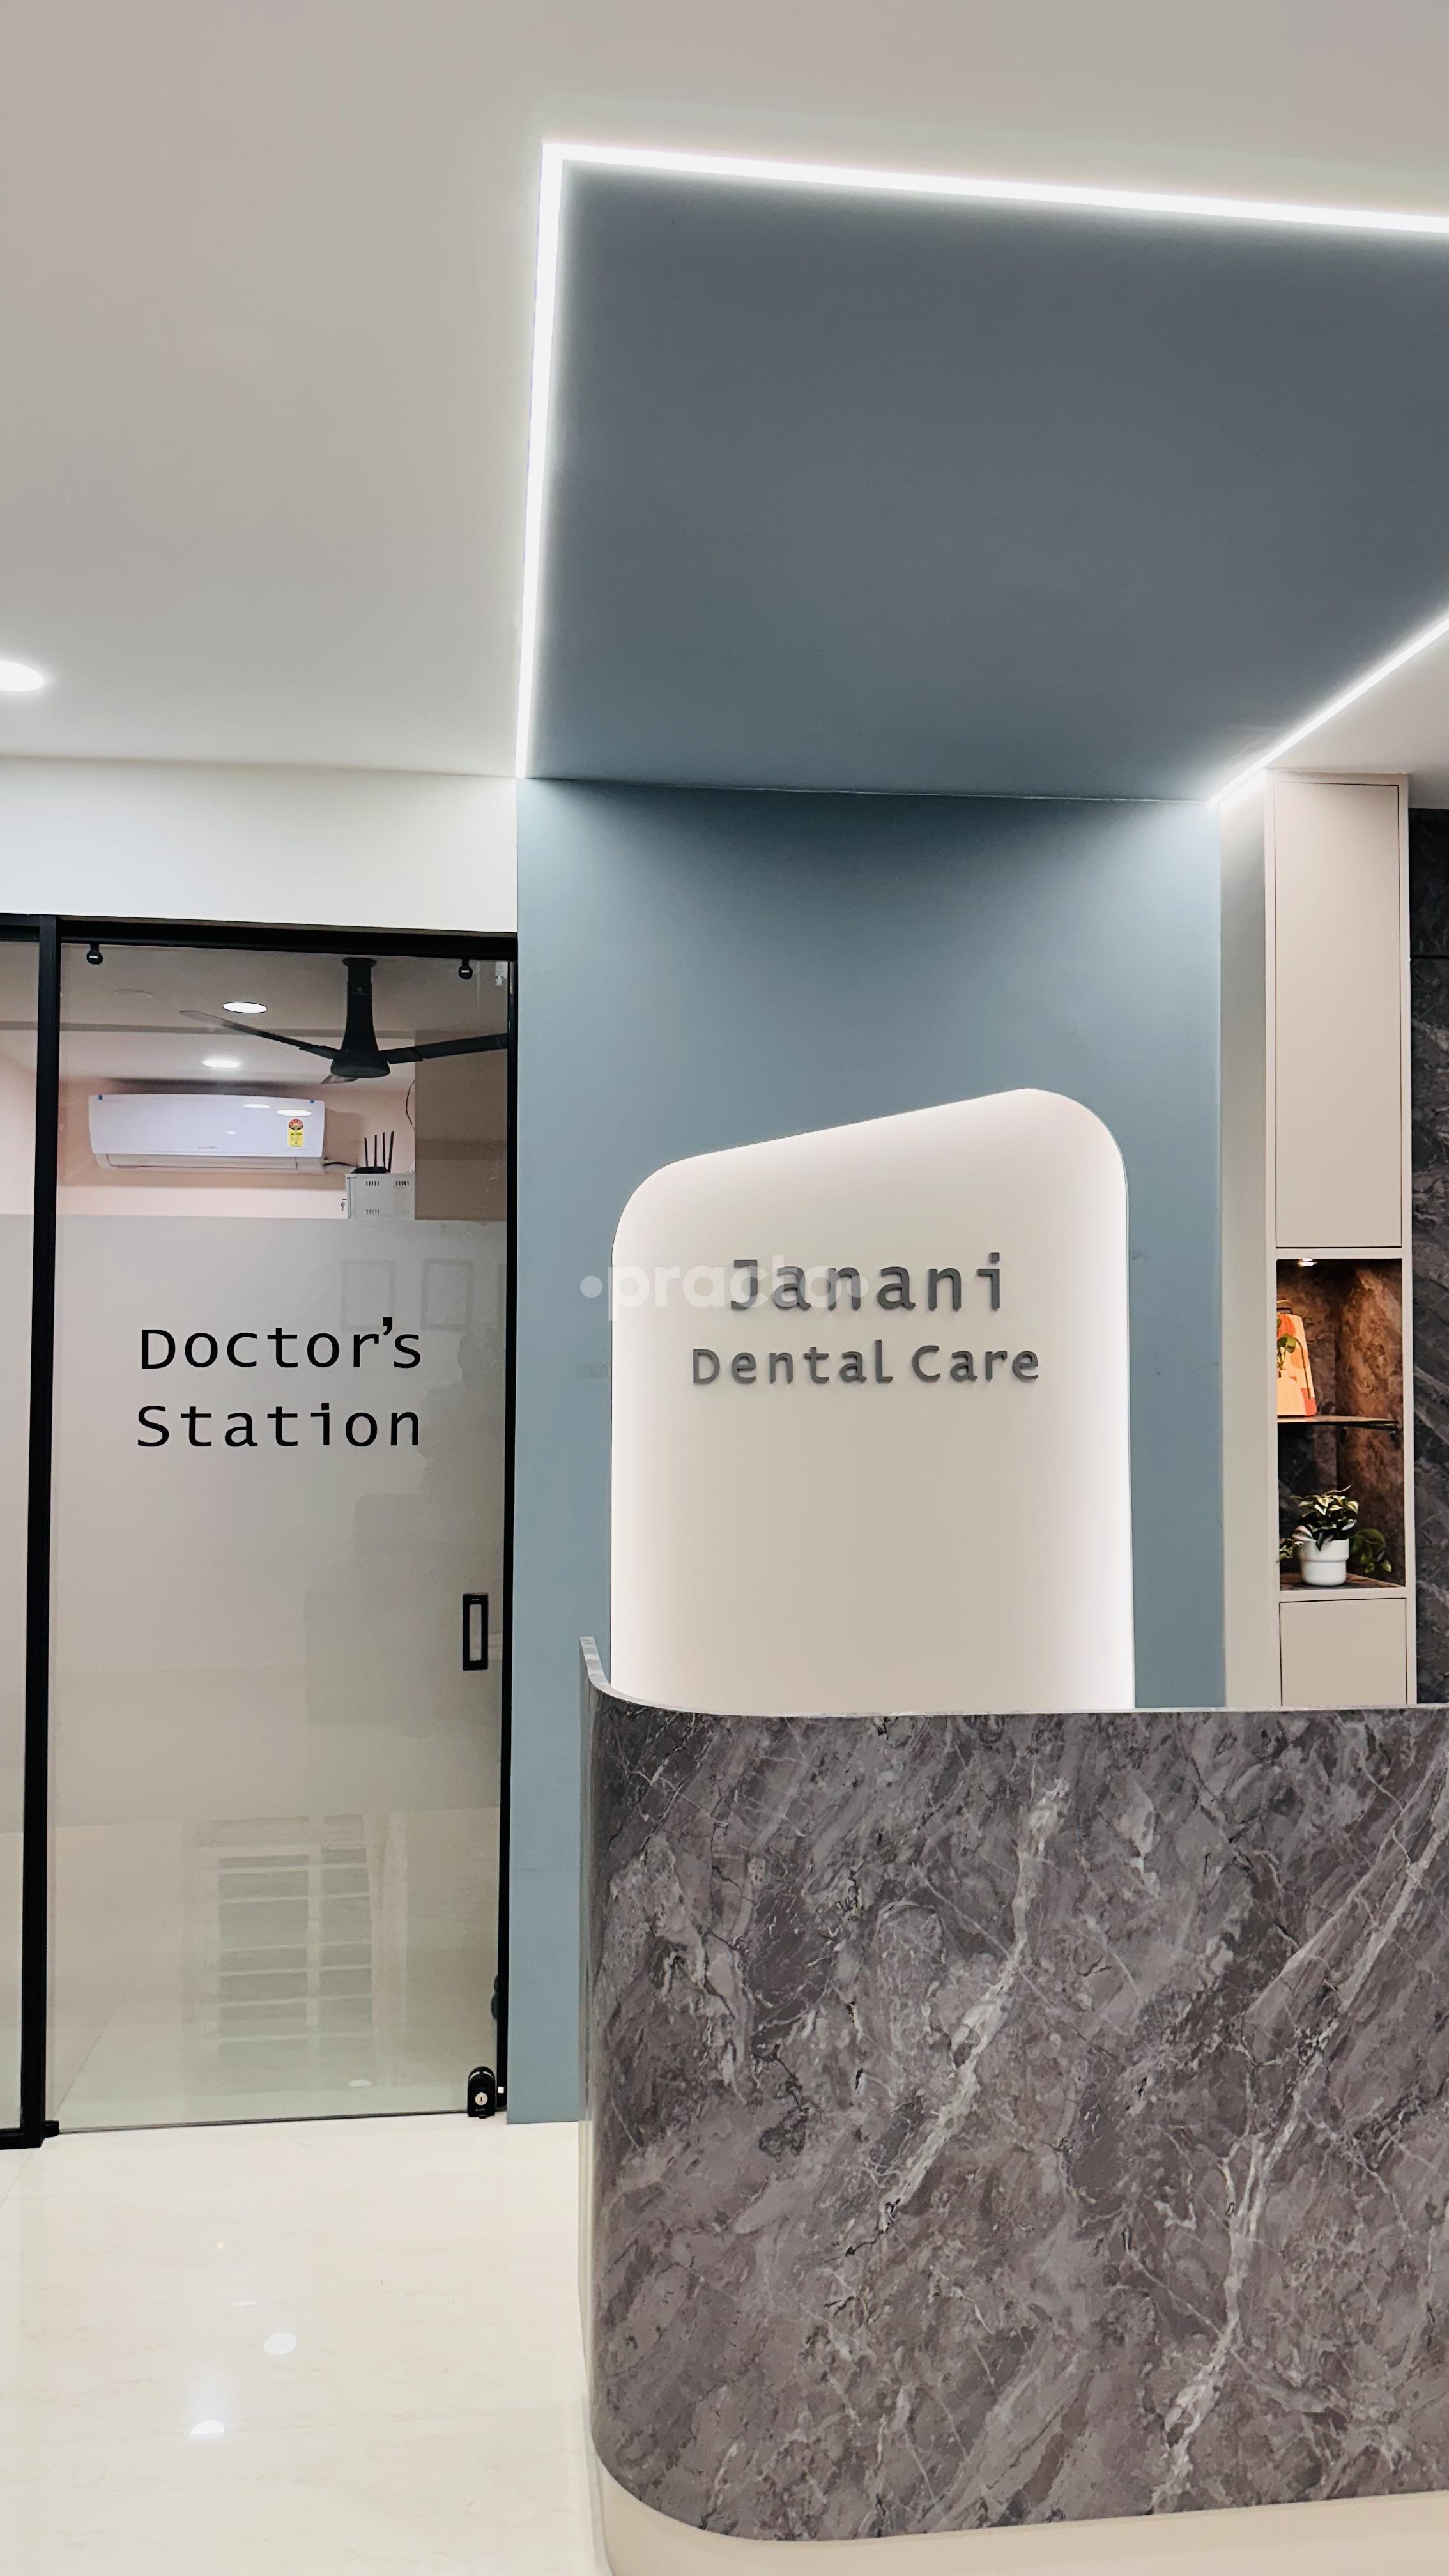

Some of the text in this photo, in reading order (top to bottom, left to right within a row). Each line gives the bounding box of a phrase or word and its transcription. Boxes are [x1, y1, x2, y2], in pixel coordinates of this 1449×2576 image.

[731, 1252, 1000, 1311] Janani
[141, 1317, 421, 1369] Doctor's
[693, 1340, 1039, 1384] Dental Care
[137, 1402, 418, 1447] Station
